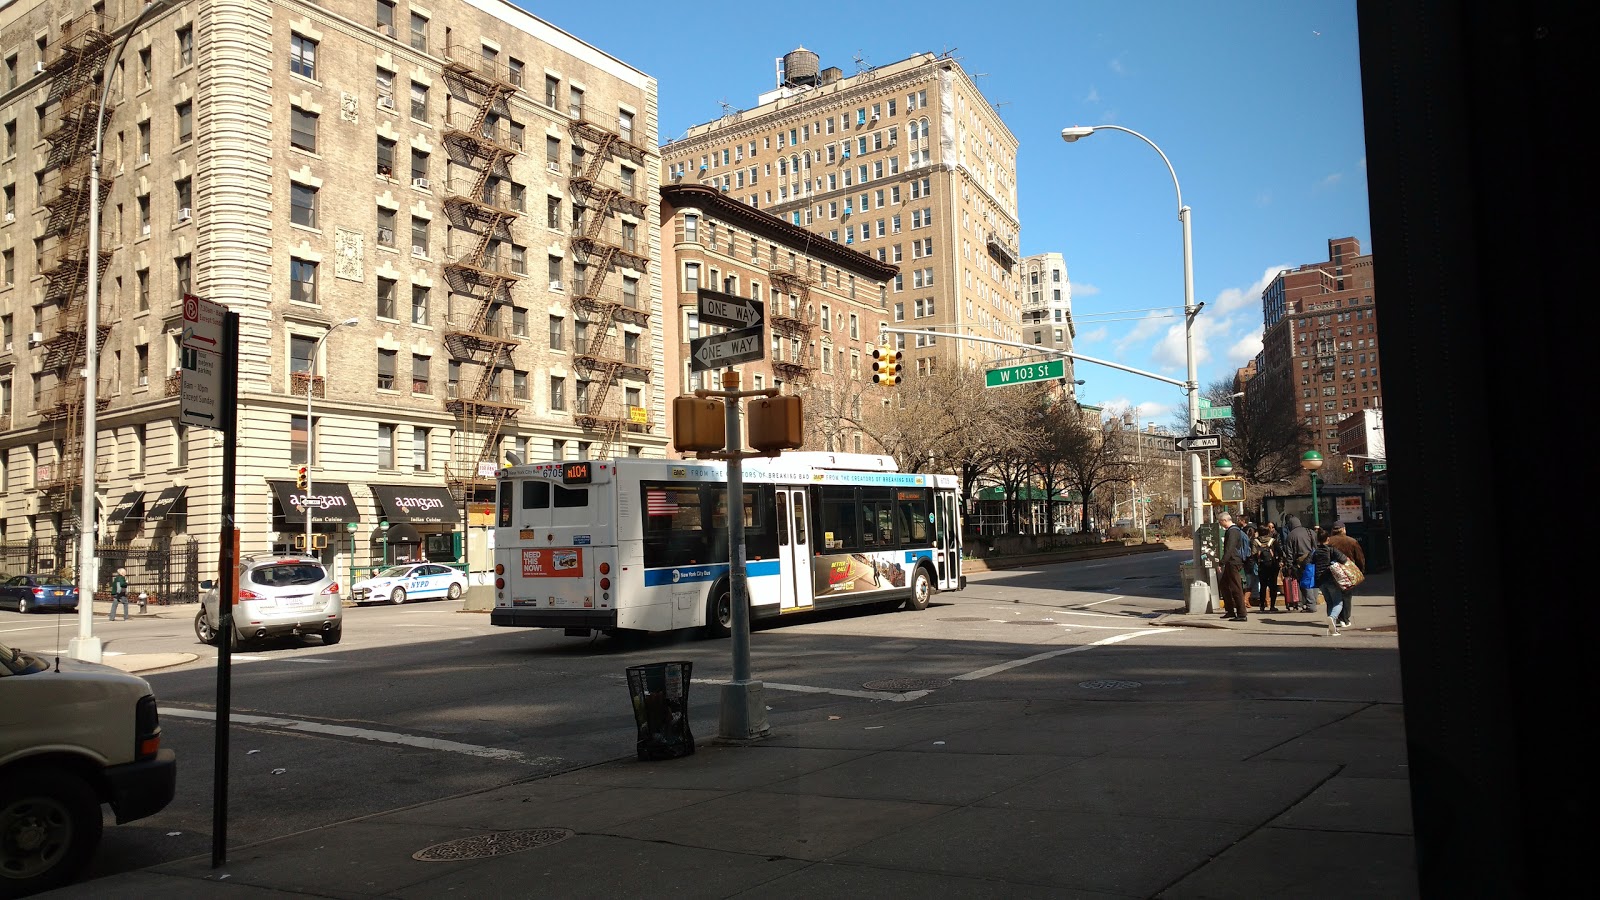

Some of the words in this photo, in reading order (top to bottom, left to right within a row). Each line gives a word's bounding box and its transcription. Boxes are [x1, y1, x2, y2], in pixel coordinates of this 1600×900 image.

[708, 301, 728, 317] ONE
[735, 306, 755, 322] WAY
[701, 344, 722, 360] ONE
[731, 338, 754, 354] WAY
[186, 348, 192, 368] 1
[198, 368, 212, 376] parking
[1000, 370, 1010, 382] W
[1014, 368, 1034, 380] 103
[1038, 364, 1049, 377] St
[183, 392, 198, 402] Except
[199, 396, 214, 406] Sunday
[1201, 409, 1208, 418] W
[1210, 408, 1222, 417] 103
[543, 469, 562, 478] 6705
[394, 496, 444, 511] aangan
[410, 580, 430, 589] NYPD
